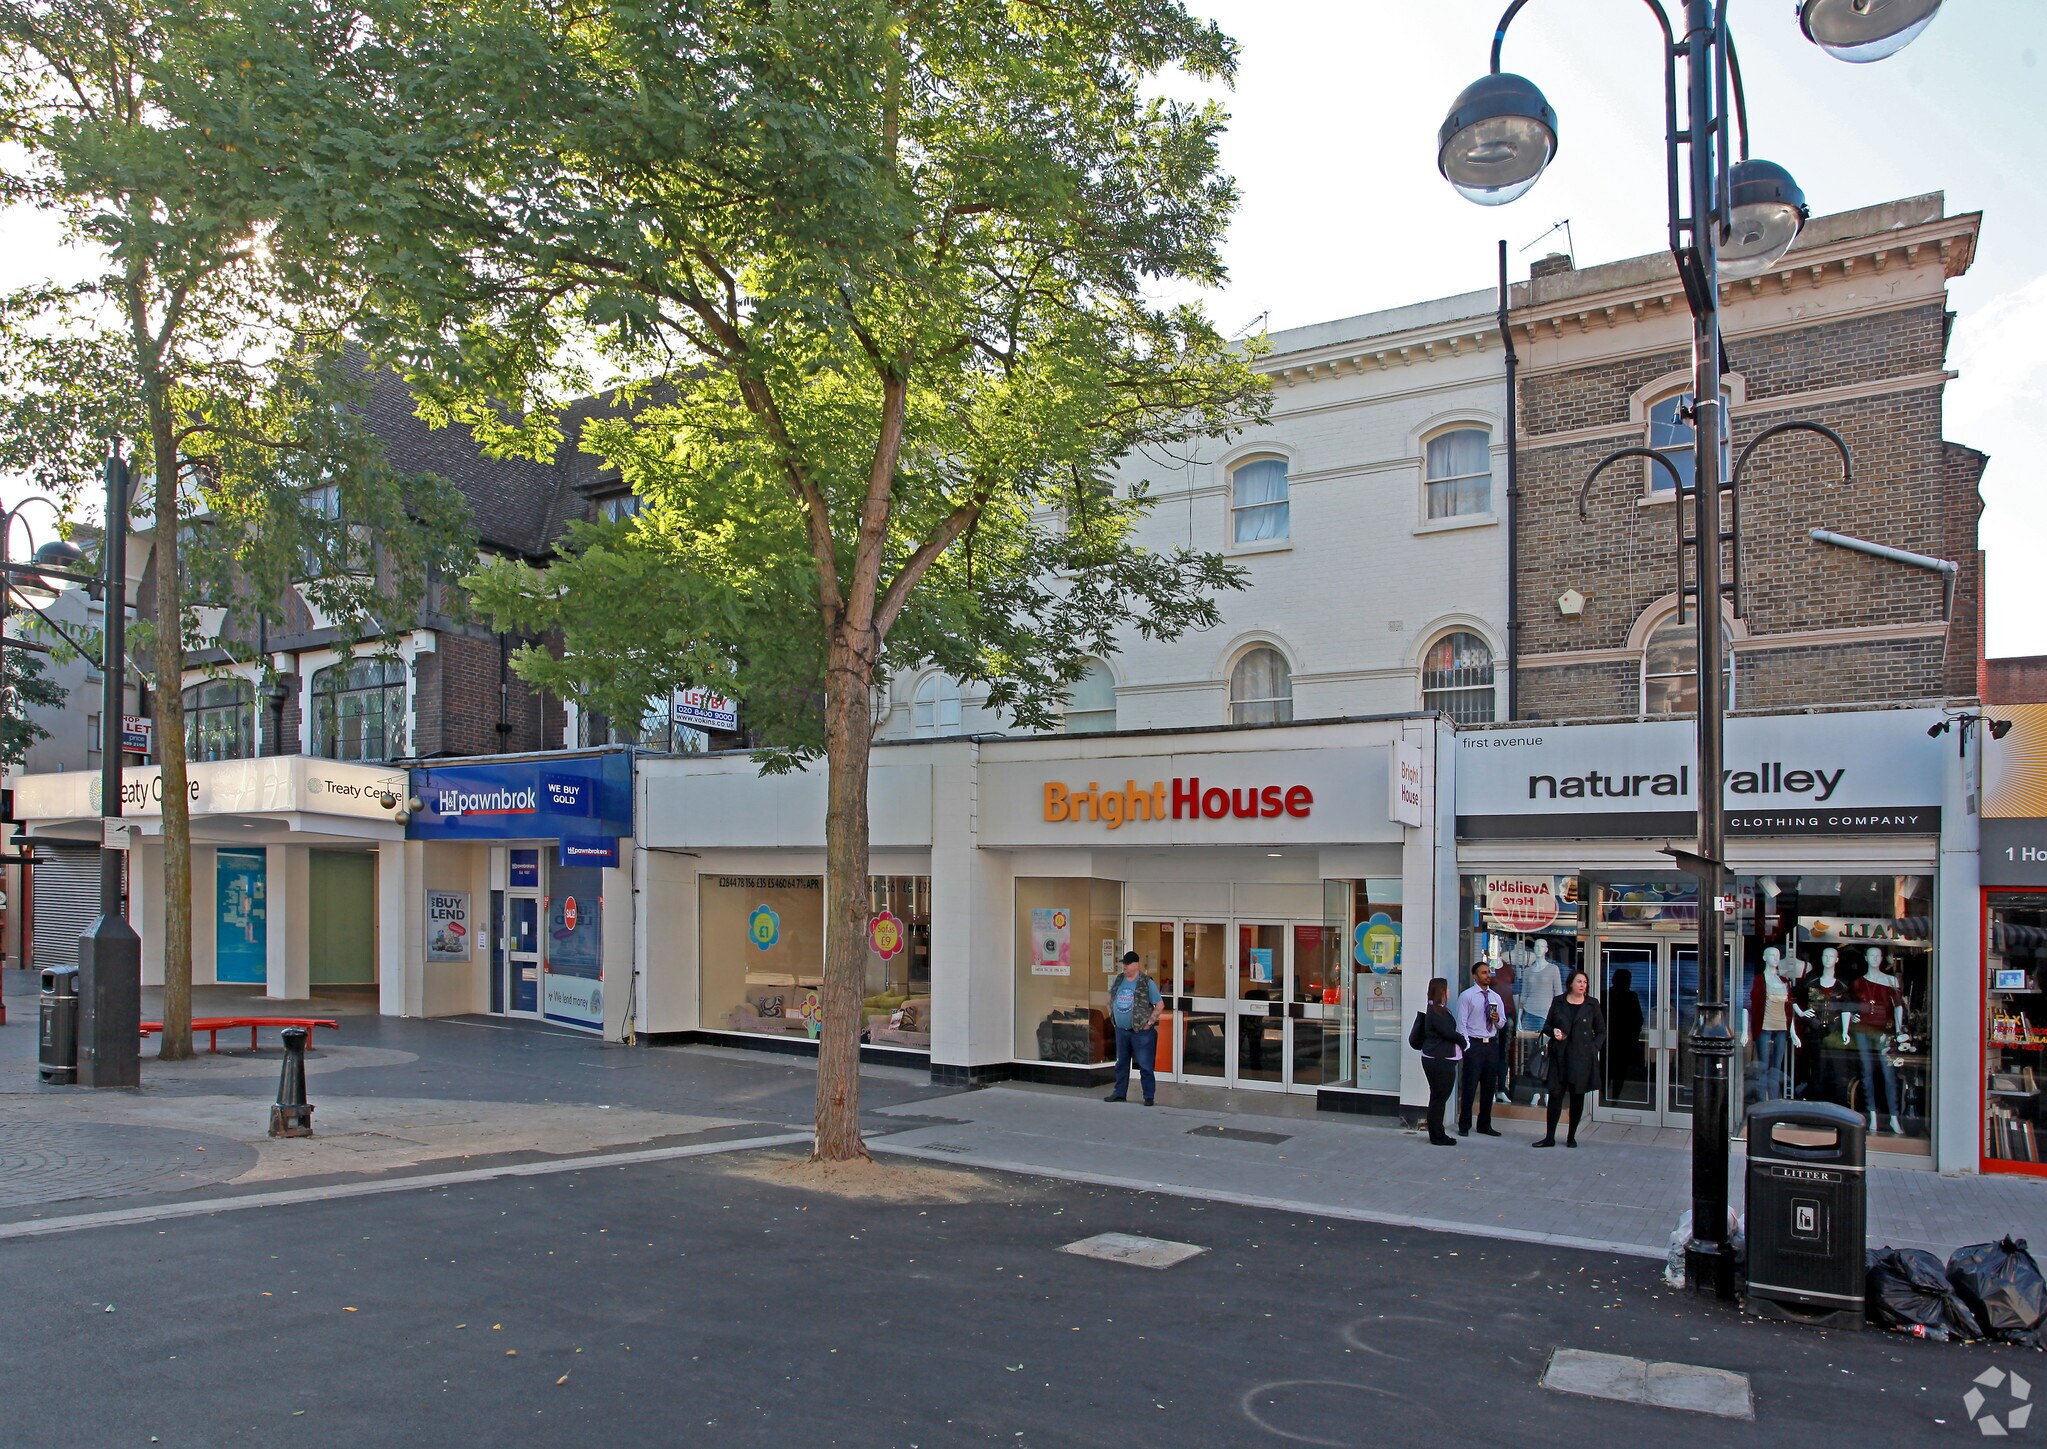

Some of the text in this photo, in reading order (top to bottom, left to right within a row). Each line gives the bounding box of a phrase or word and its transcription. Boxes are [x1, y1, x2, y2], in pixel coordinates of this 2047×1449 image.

[122, 715, 141, 723] HOP
[678, 706, 692, 714] 020
[714, 712, 733, 721] 9000
[126, 722, 152, 734] LET
[1462, 736, 1544, 748] first avenue
[1401, 761, 1419, 785] Bright
[324, 779, 362, 799] Treaty
[1528, 765, 1689, 800] natural
[122, 779, 150, 809] eaty
[548, 783, 580, 796] WE BUY
[1401, 783, 1419, 806] House
[458, 786, 537, 815] pawnbrok
[553, 794, 576, 806] GOLD
[1731, 814, 1920, 828] CLOTHING COMPANY
[2005, 847, 2014, 861] 1
[806, 879, 820, 889] APR
[436, 897, 462, 909] BUY
[1501, 895, 1547, 923] SALE
[431, 908, 465, 920] LEND
[758, 925, 769, 939] £1
[877, 924, 895, 934] Sofas
[881, 936, 891, 947] £9
[553, 990, 590, 1011] We lend money
[1995, 1014, 2022, 1026] FAX
[1783, 1168, 1829, 1180] LITTER
